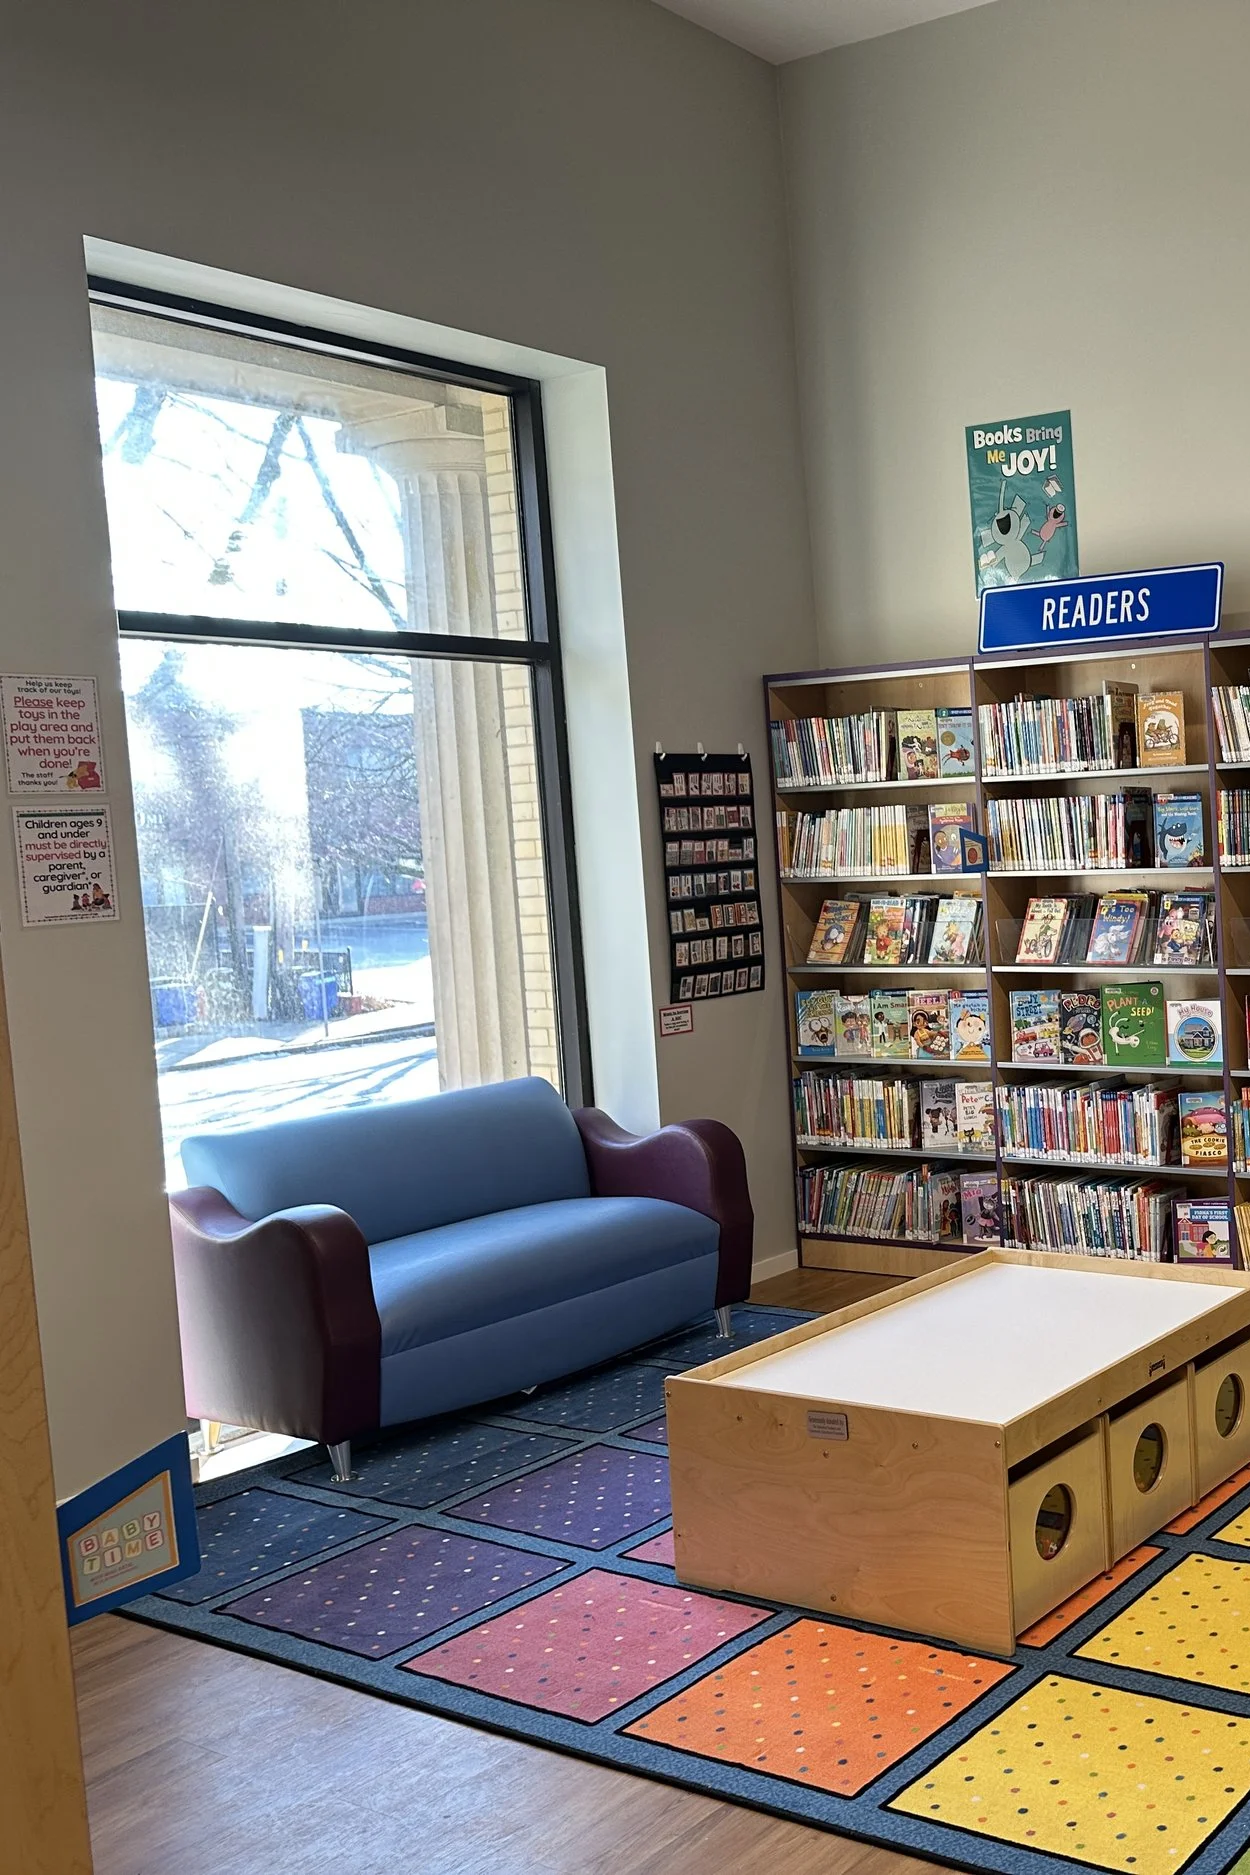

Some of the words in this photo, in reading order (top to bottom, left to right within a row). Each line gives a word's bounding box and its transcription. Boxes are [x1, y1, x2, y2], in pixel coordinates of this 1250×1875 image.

[973, 425, 1022, 449] Books
[1026, 426, 1062, 444] Bring
[987, 450, 1005, 464] Me
[1001, 445, 1057, 477] JOY!
[1041, 587, 1151, 631] READERS
[25, 680, 42, 688] Help
[14, 696, 53, 708] Please
[56, 697, 85, 710] keep
[18, 710, 45, 721] toys
[48, 710, 58, 719] in
[61, 710, 80, 720] the
[10, 721, 37, 733] play
[40, 724, 68, 732] area
[71, 722, 93, 732] and
[10, 735, 31, 745] put
[33, 735, 65, 744] them
[68, 735, 96, 744] back
[18, 746, 50, 756] when
[53, 747, 90, 758] you're
[39, 759, 72, 769] done!
[25, 820, 67, 829] Children
[69, 821, 94, 829] ages
[96, 818, 103, 827] 9
[38, 830, 58, 839] and
[60, 830, 90, 839] under
[25, 842, 52, 850] must
[54, 840, 67, 849] be
[69, 839, 106, 849] directly
[25, 850, 81, 862] supervised
[83, 850, 97, 860] by
[48, 862, 86, 872] parent,
[1016, 1004, 1042, 1017] STREET
[1106, 997, 1138, 1012] PLANT
[1130, 1007, 1154, 1017] SEED!
[962, 1095, 978, 1103] Pete
[84, 1514, 158, 1552] BABY
[87, 1533, 160, 1571] TIME
